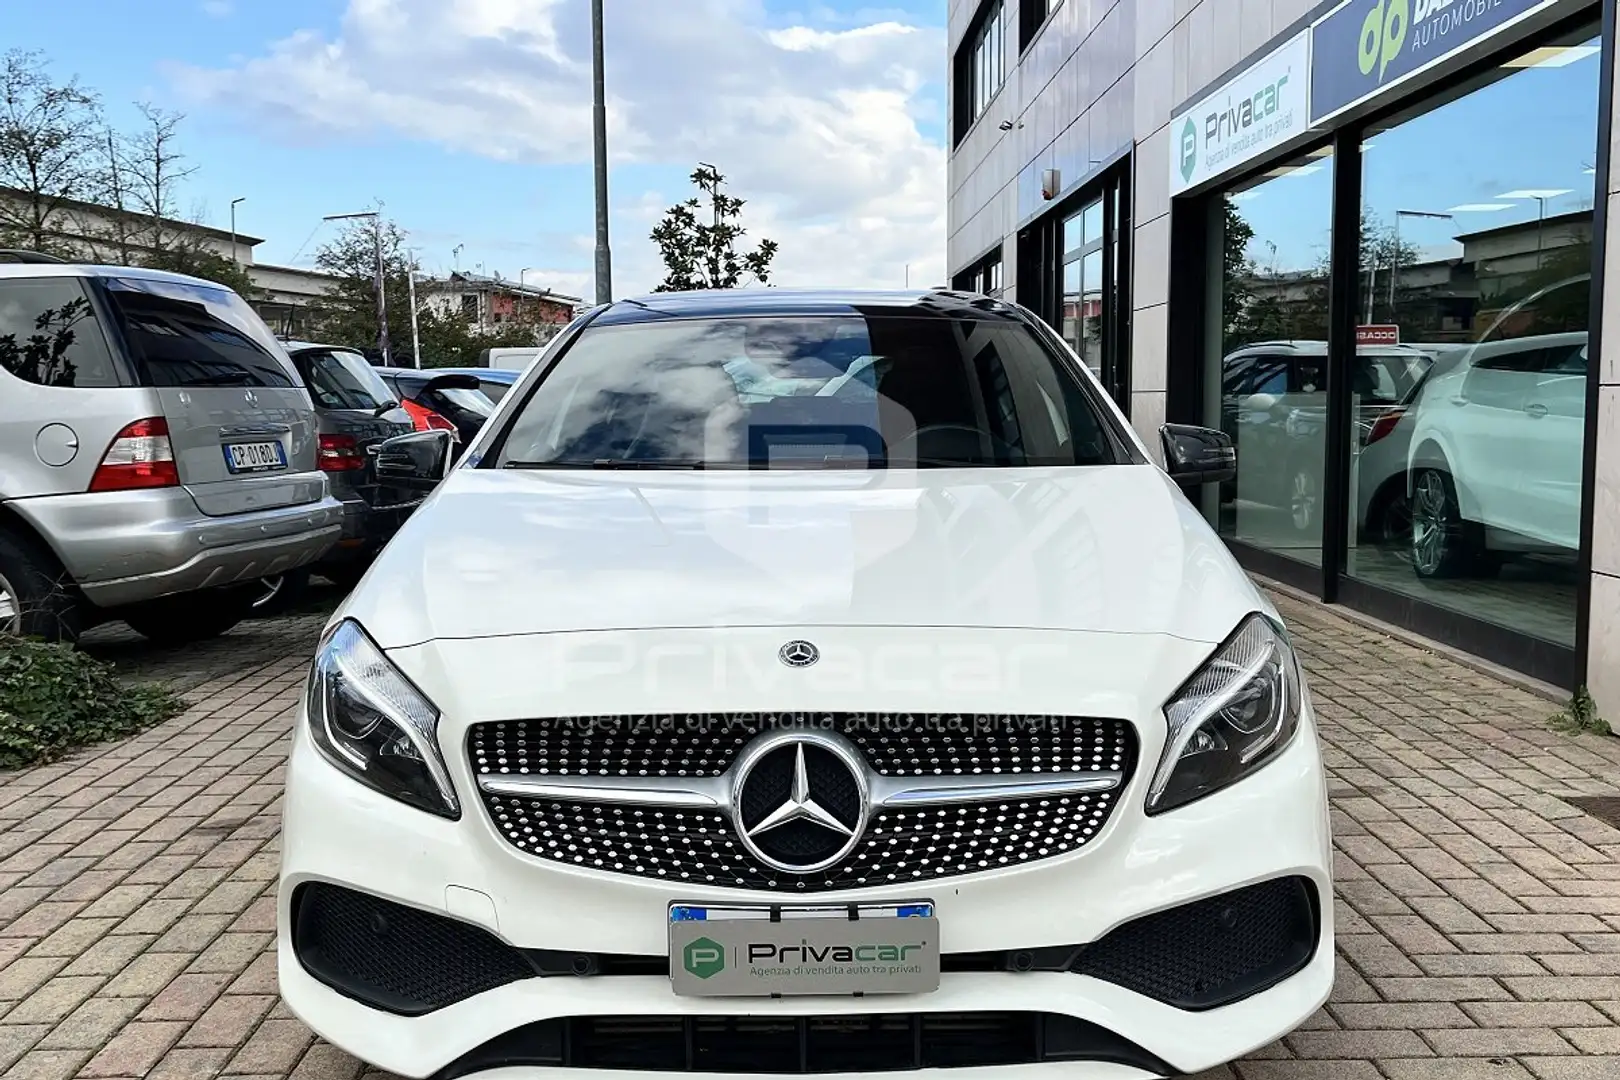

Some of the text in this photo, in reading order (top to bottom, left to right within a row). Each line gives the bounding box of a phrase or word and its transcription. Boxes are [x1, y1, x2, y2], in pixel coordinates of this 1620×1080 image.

[1412, 0, 1501, 52] AUTOMOB
[1205, 75, 1289, 150] Privacar
[232, 446, 246, 465] CP
[748, 939, 923, 964] Privacar
[750, 965, 922, 977] Agenzia di vendita auto tra privati
